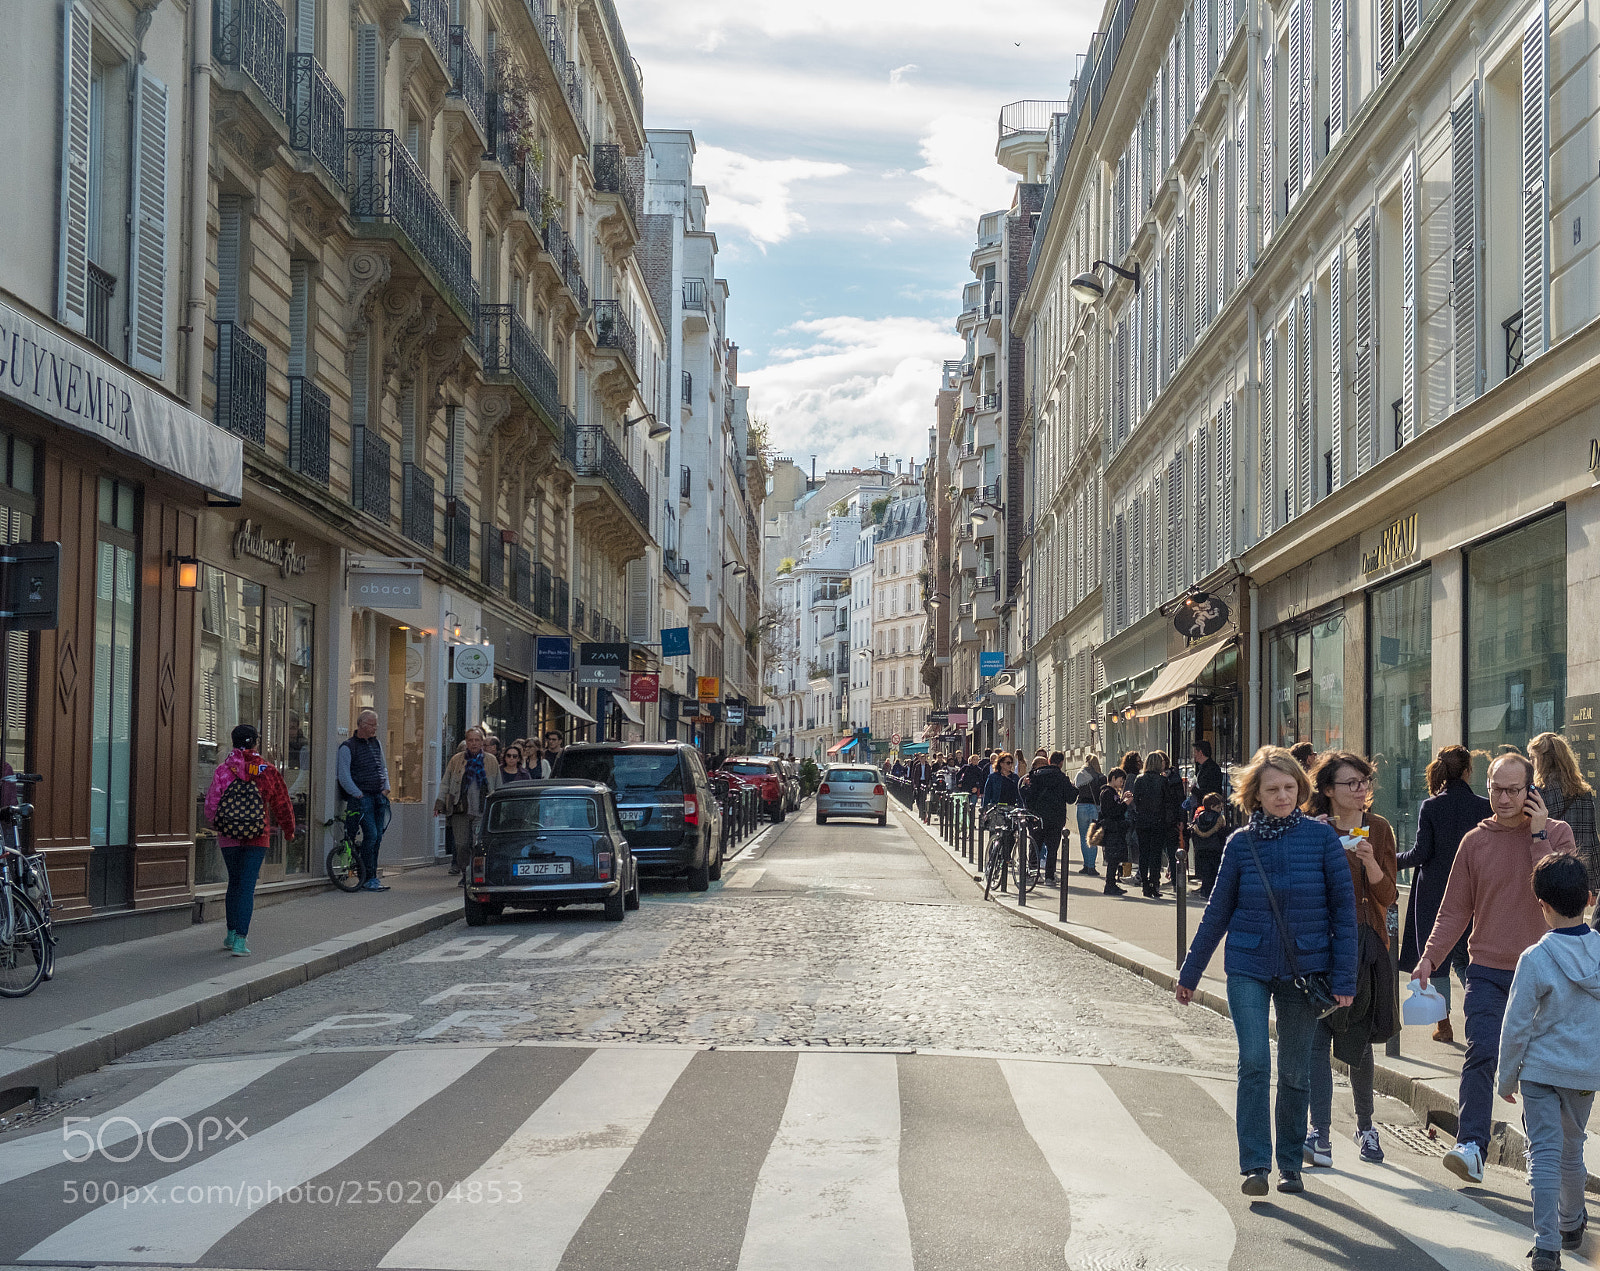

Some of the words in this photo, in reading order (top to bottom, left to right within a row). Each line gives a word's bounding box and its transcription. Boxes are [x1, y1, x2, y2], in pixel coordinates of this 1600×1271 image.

[360, 583, 411, 595] abaca
[591, 652, 619, 660] ZAPA
[519, 865, 530, 874] 32
[553, 864, 564, 873] 75
